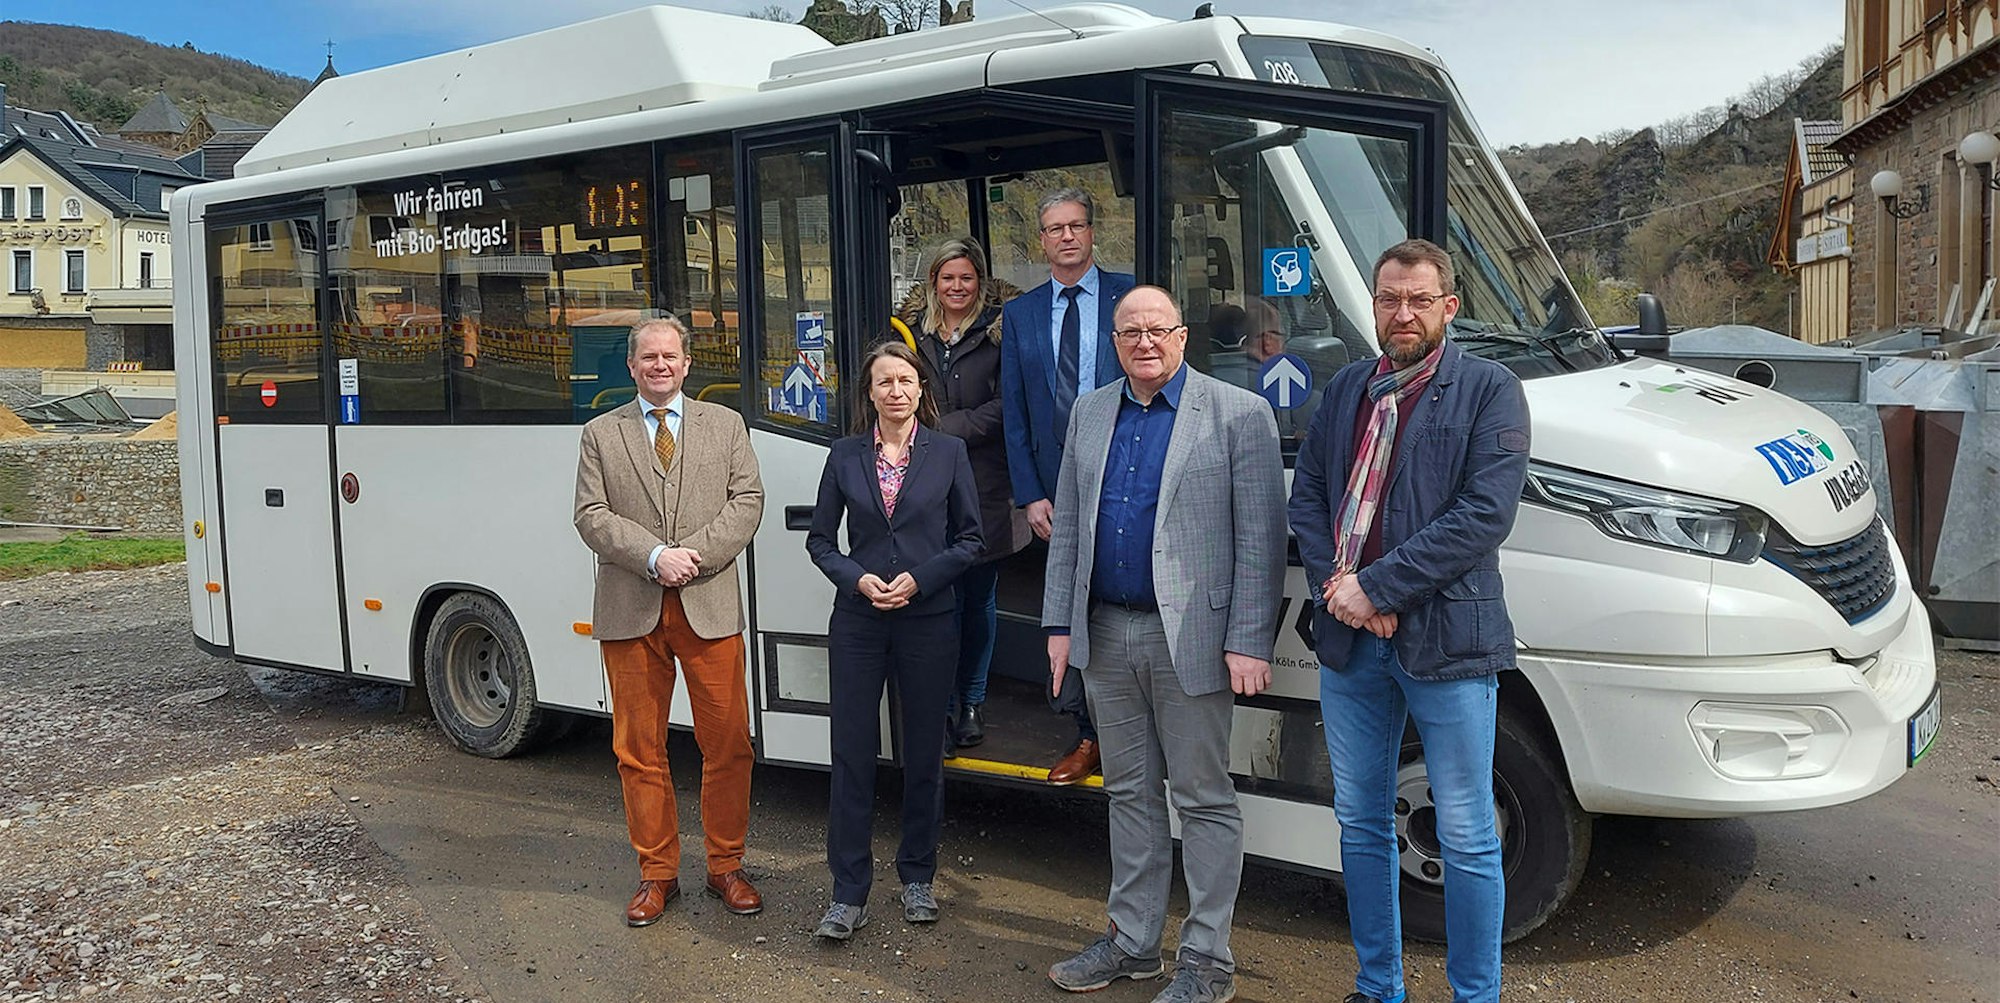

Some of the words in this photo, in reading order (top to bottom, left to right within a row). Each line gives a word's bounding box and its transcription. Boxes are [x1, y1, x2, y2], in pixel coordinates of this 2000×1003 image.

[1264, 60, 1299, 84] 208
[393, 189, 423, 217] Wir
[425, 186, 483, 212] fahren
[41, 227, 94, 242] POST
[137, 230, 171, 245] HOTEL
[376, 231, 404, 257] mit
[408, 218, 508, 254] Bio-Erdgas!
[1275, 656, 1296, 668] Köln
[1298, 659, 1320, 670] Gmb
